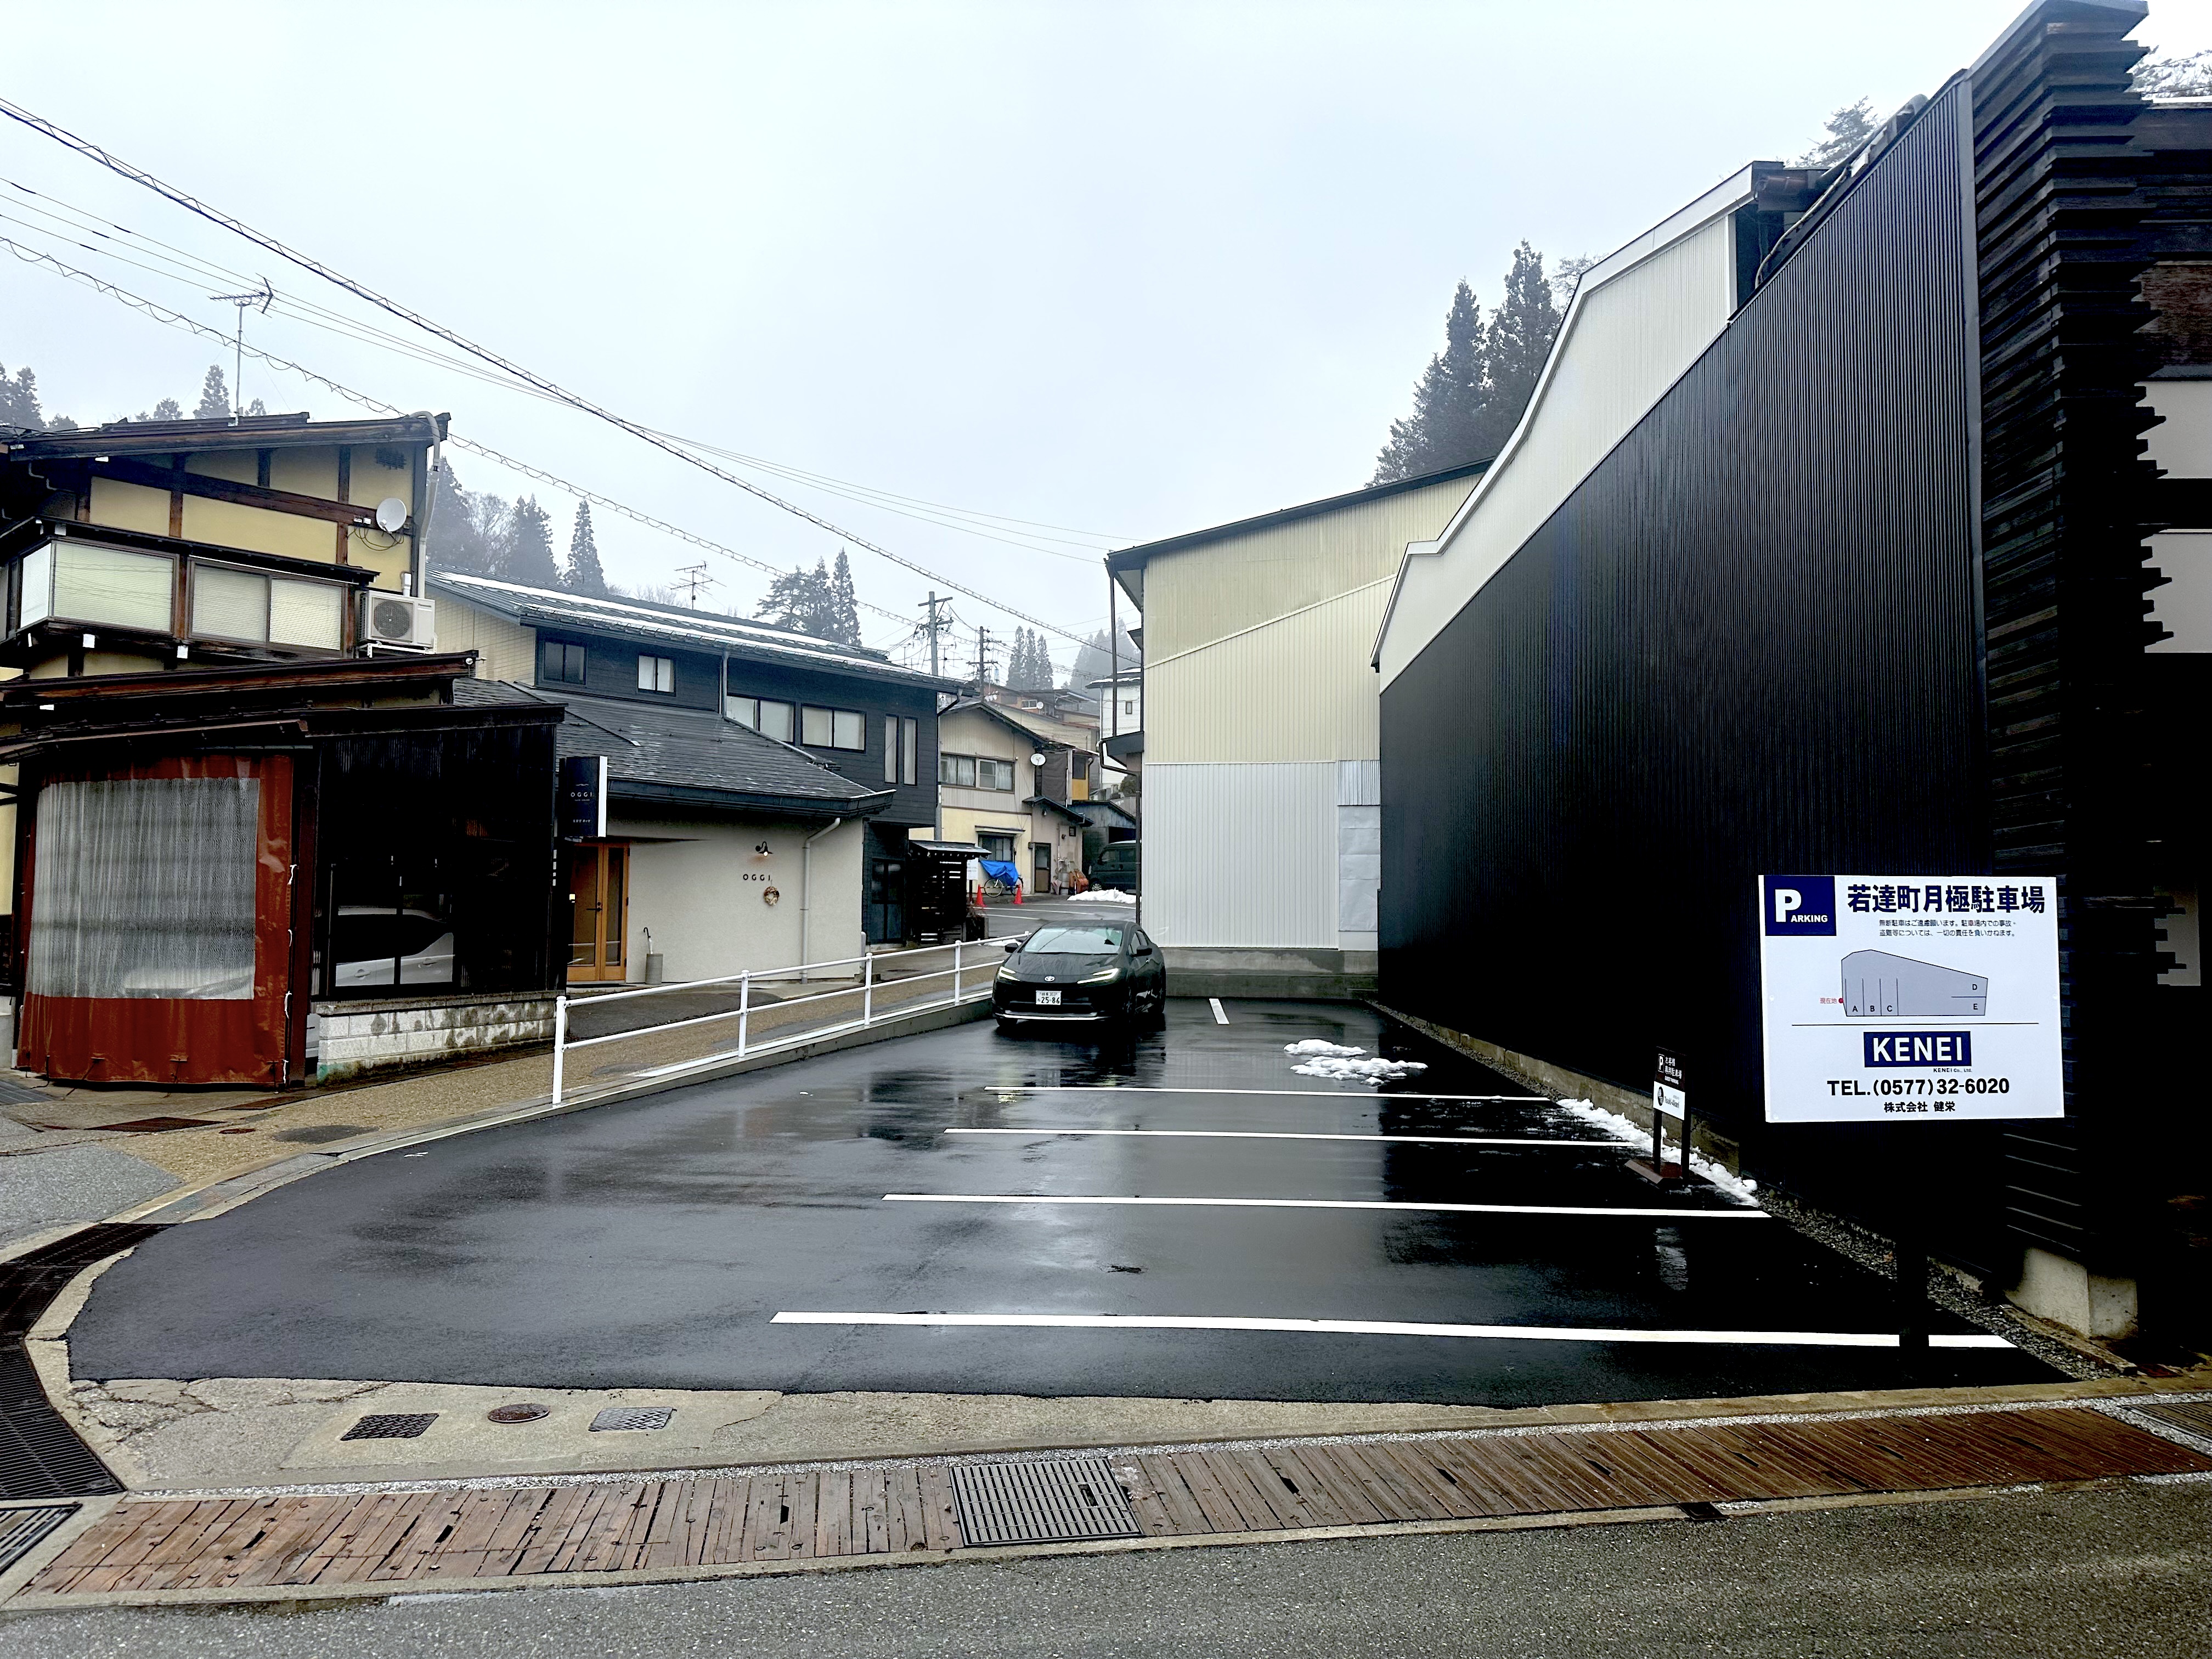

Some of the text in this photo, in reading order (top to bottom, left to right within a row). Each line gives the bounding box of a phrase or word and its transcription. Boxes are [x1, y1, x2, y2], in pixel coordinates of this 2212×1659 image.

[1848, 884, 2045, 913] 若達町月極駐車場
[1873, 1036, 1963, 1062] KENEI
[1659, 1056, 1663, 1070] P
[1827, 1078, 2010, 1096] TEL.(0577)32-6020
[1884, 1101, 1956, 1113] 株式会社 健栄
